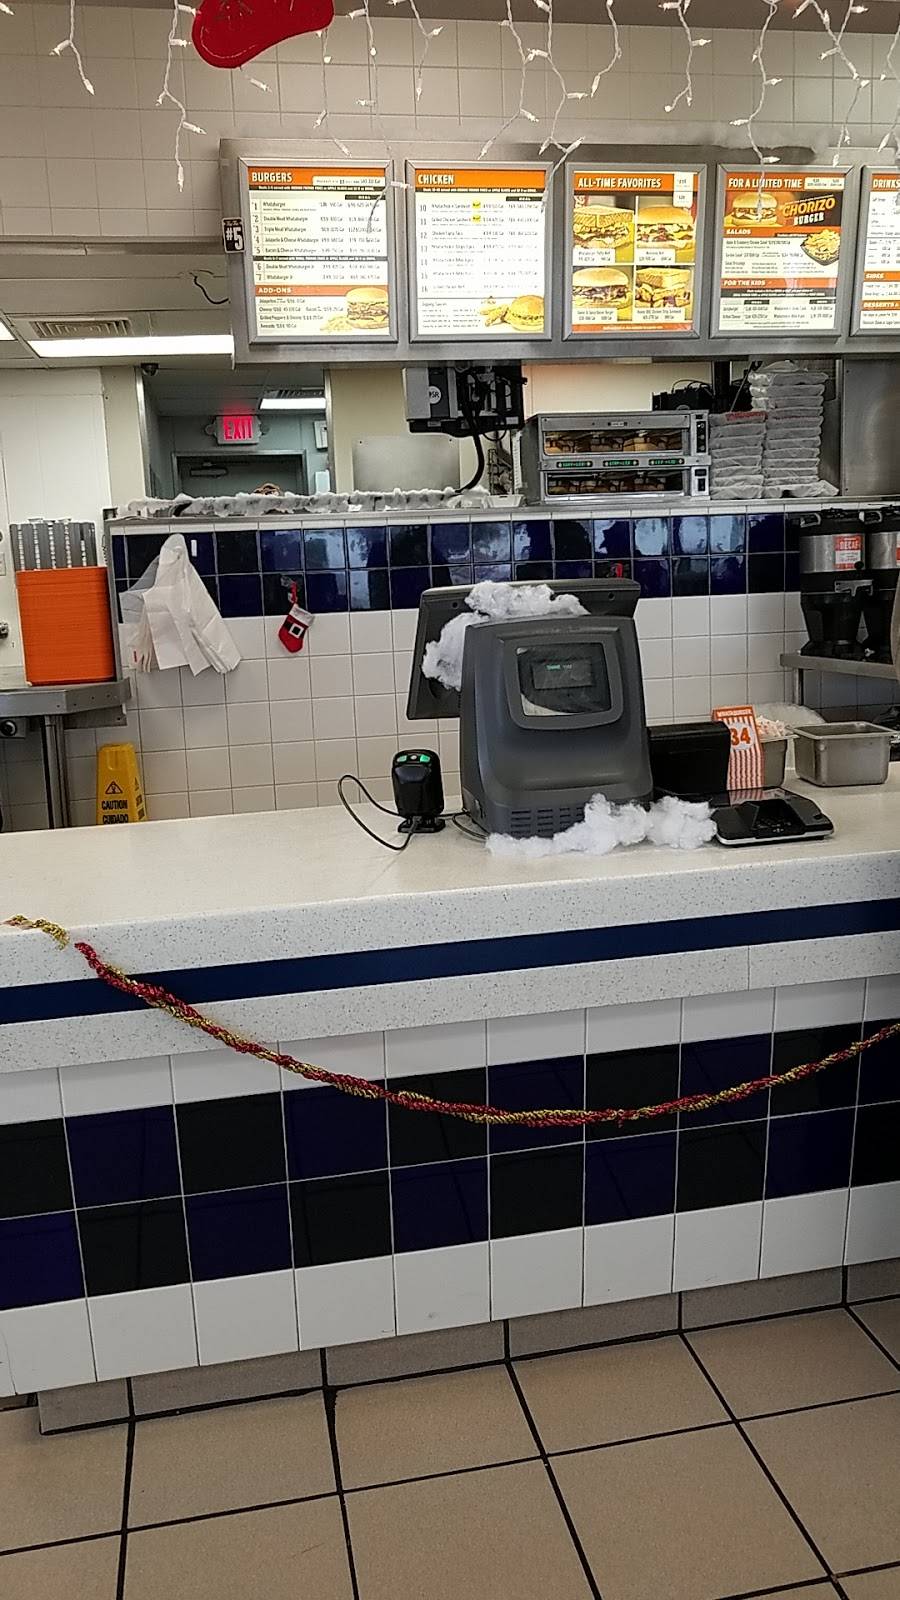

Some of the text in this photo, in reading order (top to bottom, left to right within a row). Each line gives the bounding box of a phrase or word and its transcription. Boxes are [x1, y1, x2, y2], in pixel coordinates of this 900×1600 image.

[252, 172, 292, 182] BURGERS
[418, 174, 454, 184] CHICKEN
[578, 178, 661, 188] ALL-TIME FAVORITES
[729, 179, 744, 188] FOR
[745, 179, 751, 188] A
[784, 178, 802, 188] TIME
[783, 198, 835, 217] CHORIZO
[794, 212, 824, 226] BURGER
[226, 227, 243, 249] #5
[224, 416, 253, 440] EXIT
[840, 540, 858, 549] DECAF
[731, 728, 750, 745] 34
[102, 800, 128, 810] CAUTION
[103, 814, 128, 824] CUIDADO
